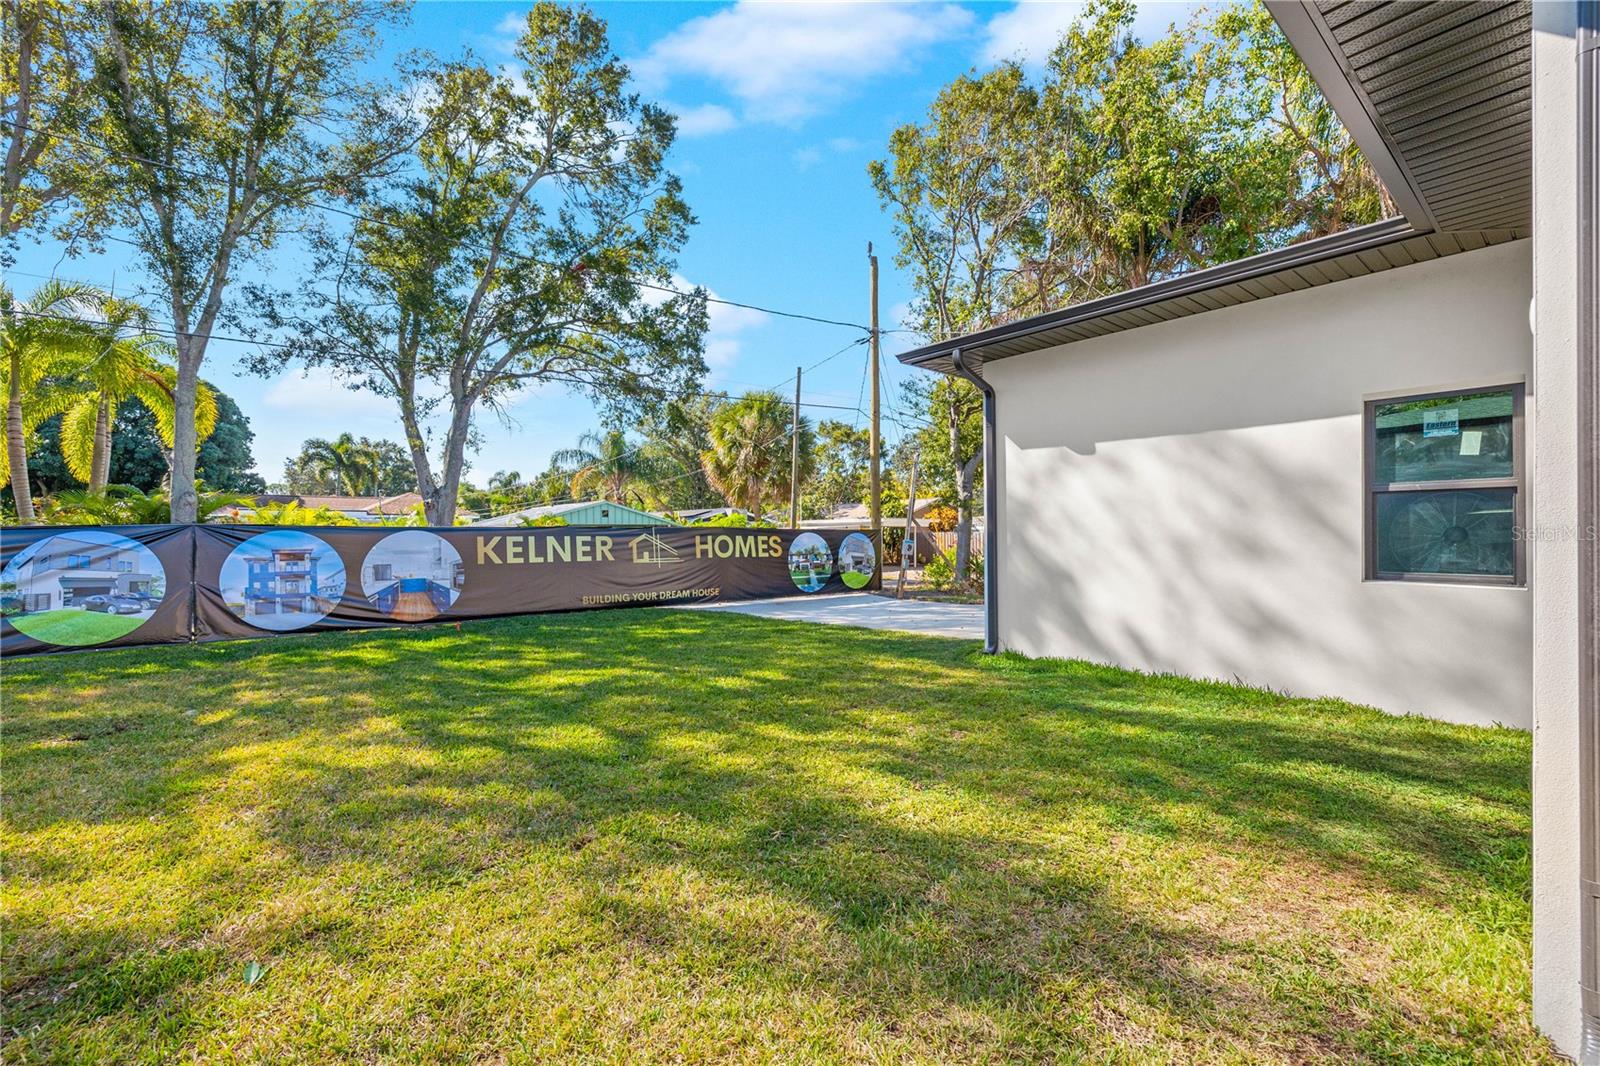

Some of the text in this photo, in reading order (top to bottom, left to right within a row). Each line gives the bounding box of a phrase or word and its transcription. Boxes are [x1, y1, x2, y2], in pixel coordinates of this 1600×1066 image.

[477, 535, 783, 564] KELNER HOMES
[582, 588, 720, 605] BUILDING YOUR DREAM HOUSE
